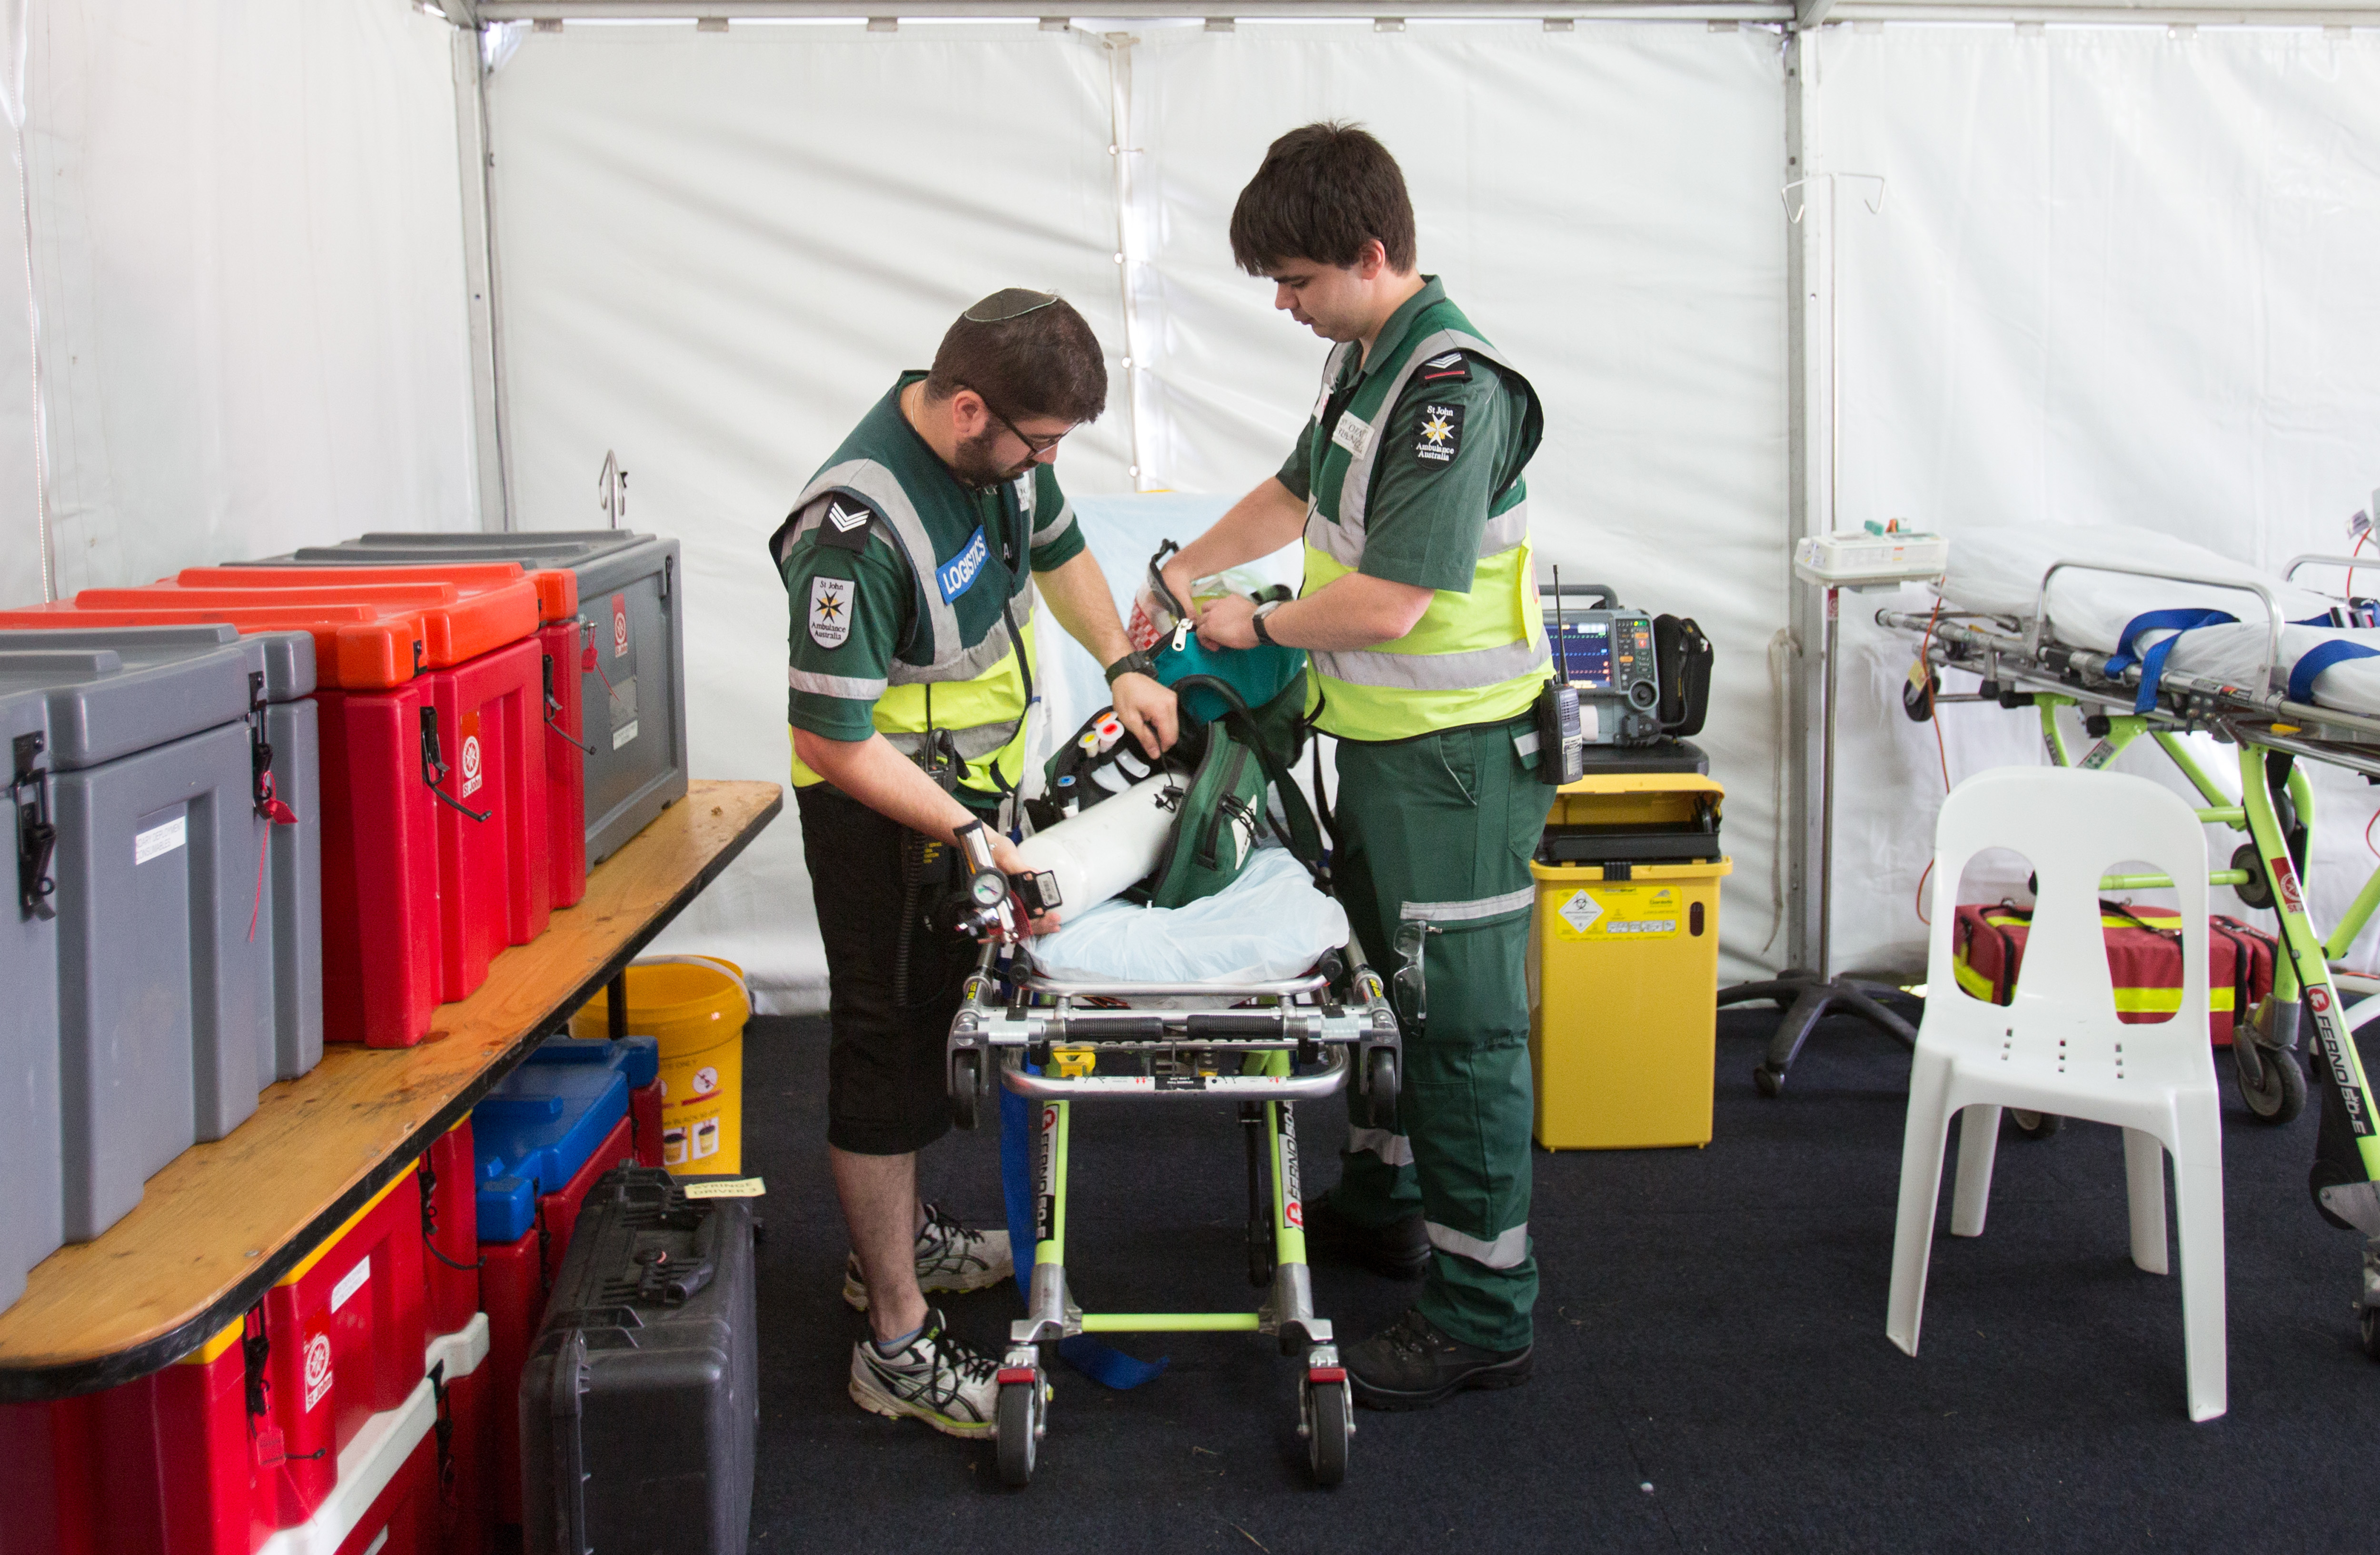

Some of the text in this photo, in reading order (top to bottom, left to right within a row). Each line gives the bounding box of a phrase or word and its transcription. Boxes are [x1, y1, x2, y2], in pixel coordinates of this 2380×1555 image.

[1427, 405, 1453, 416] St John
[1416, 442, 1454, 455] Ambulance
[1418, 450, 1449, 461] Australia
[943, 535, 986, 594] LOGISTICS
[829, 582, 843, 591] John
[811, 622, 846, 633] Ambulance
[814, 630, 842, 640] Australia
[464, 784, 469, 796] St
[2318, 1015, 2350, 1084] FERNO
[1287, 1138, 1301, 1201] FERNO
[307, 1377, 332, 1407] St John
